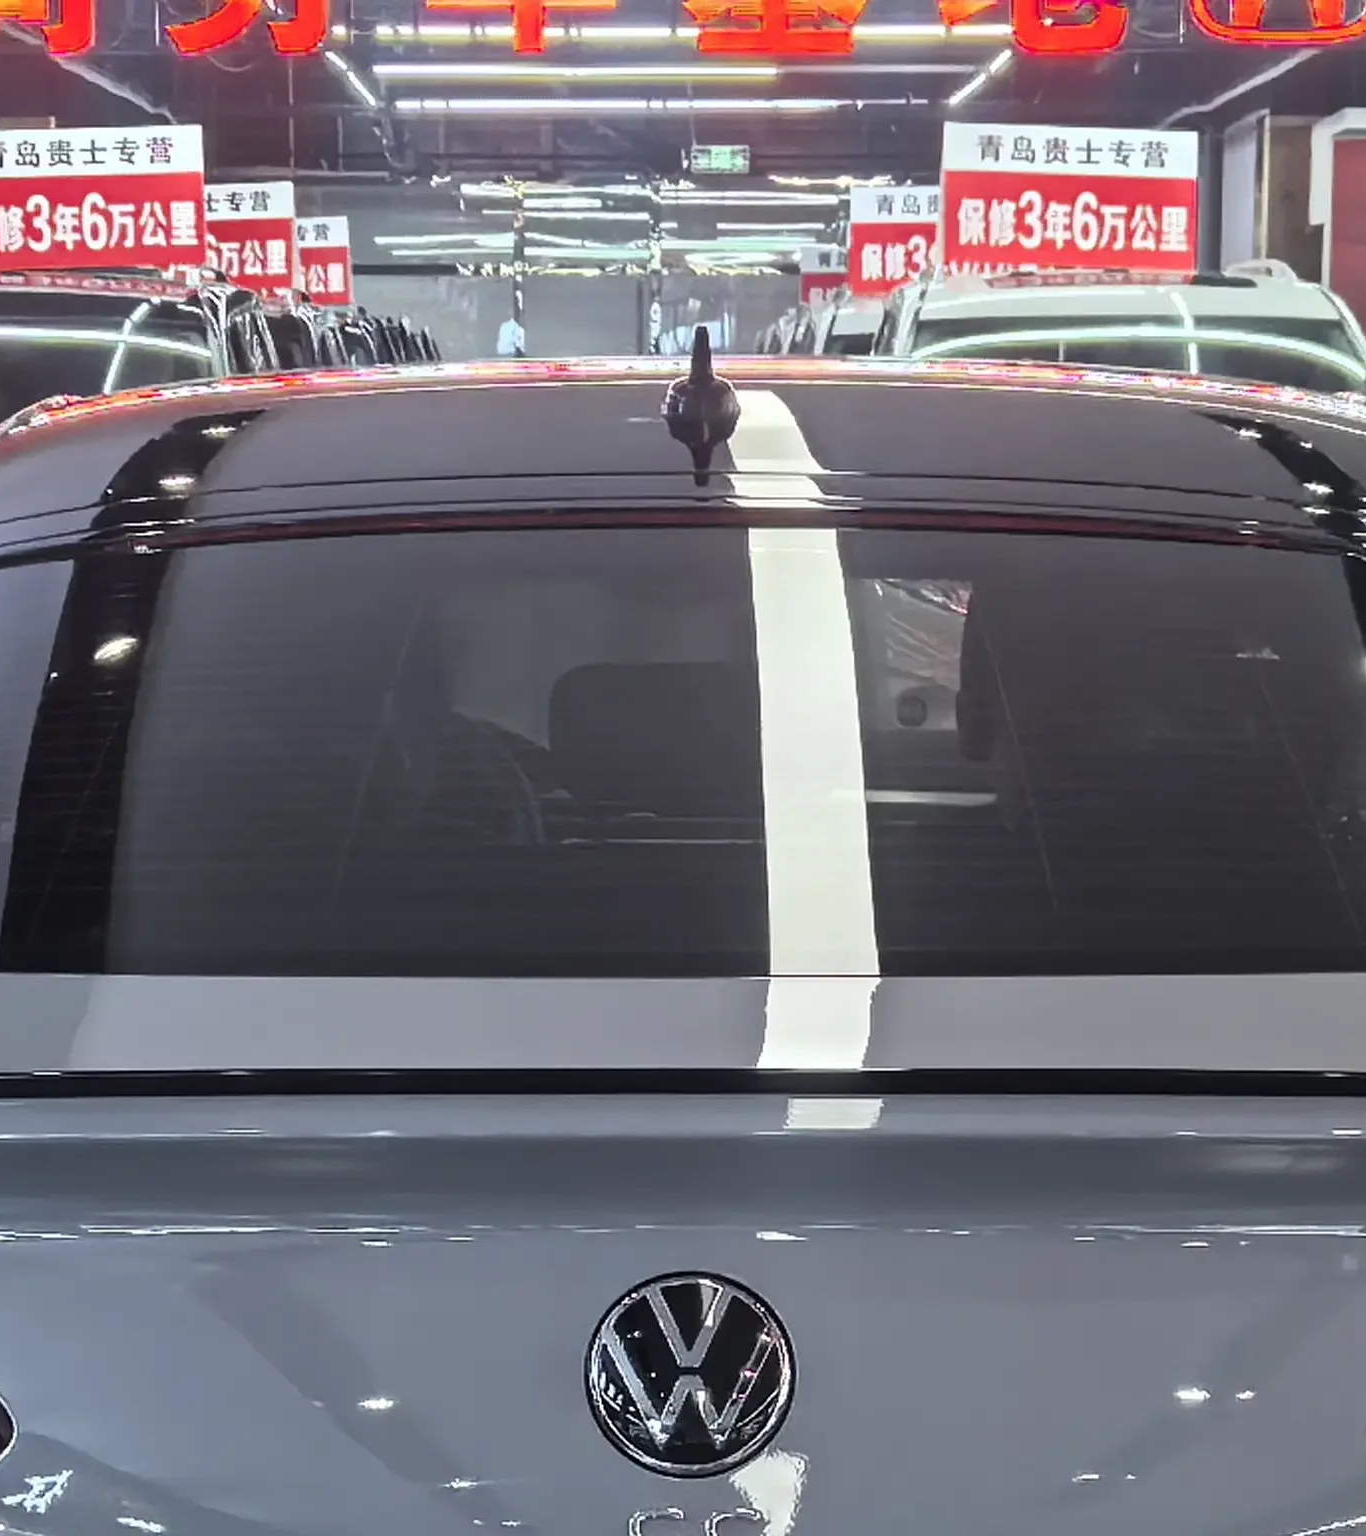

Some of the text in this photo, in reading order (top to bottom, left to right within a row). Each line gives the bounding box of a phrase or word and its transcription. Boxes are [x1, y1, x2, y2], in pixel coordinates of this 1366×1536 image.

[976, 134, 1170, 168] 青岛贵士专营
[957, 190, 1189, 253] 保修3年6万公里
